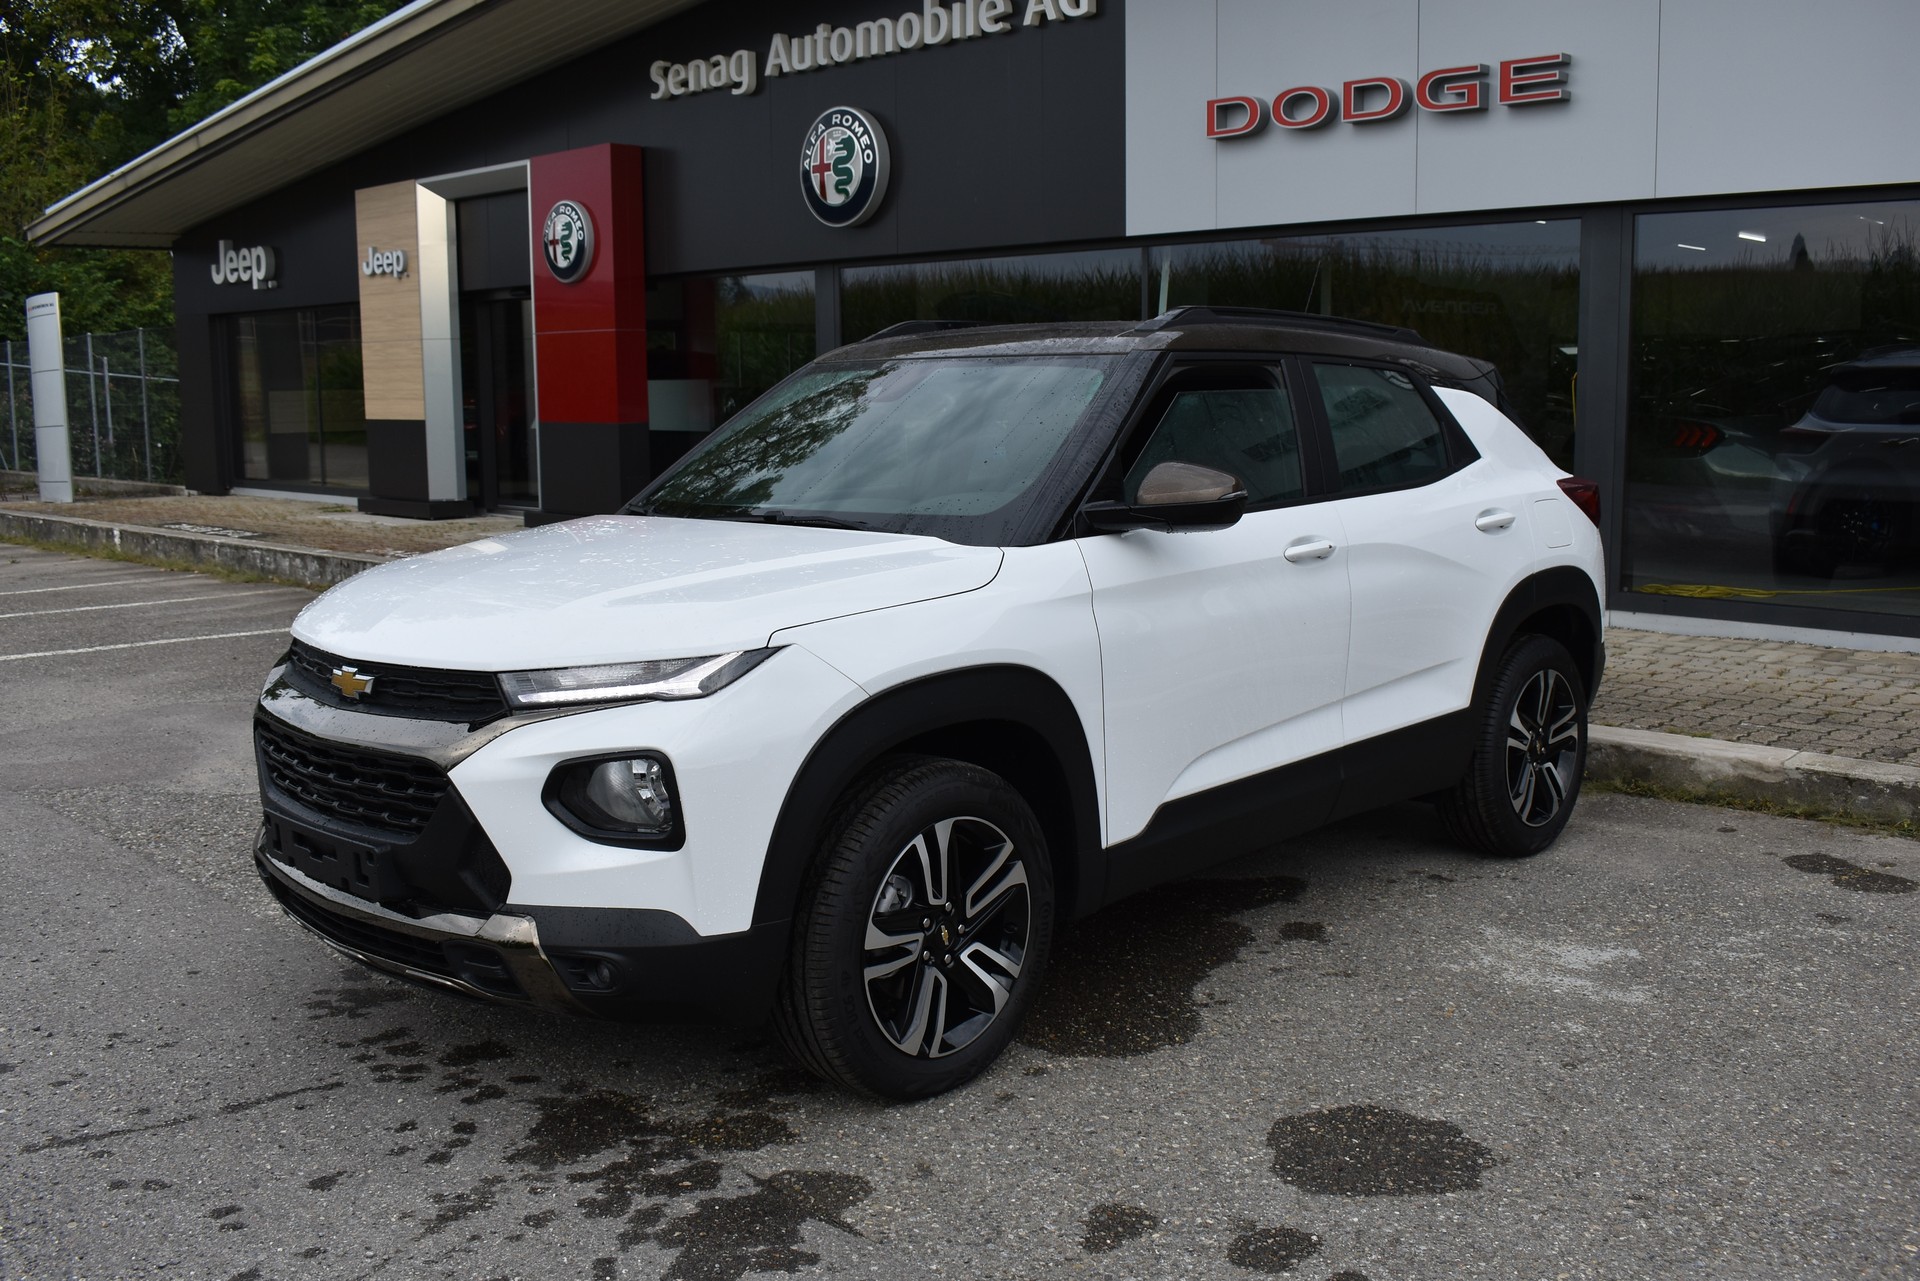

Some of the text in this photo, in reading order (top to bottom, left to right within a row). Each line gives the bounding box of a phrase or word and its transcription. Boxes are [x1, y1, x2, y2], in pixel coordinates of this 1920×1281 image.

[650, 50, 756, 99] Senag
[764, 0, 1011, 76] Automobile
[1206, 53, 1571, 140] DODGE
[804, 114, 873, 171] ALFA ROMEO
[560, 205, 584, 240] ROMEO
[211, 240, 272, 290] Jeep
[362, 246, 407, 278] Jeep
